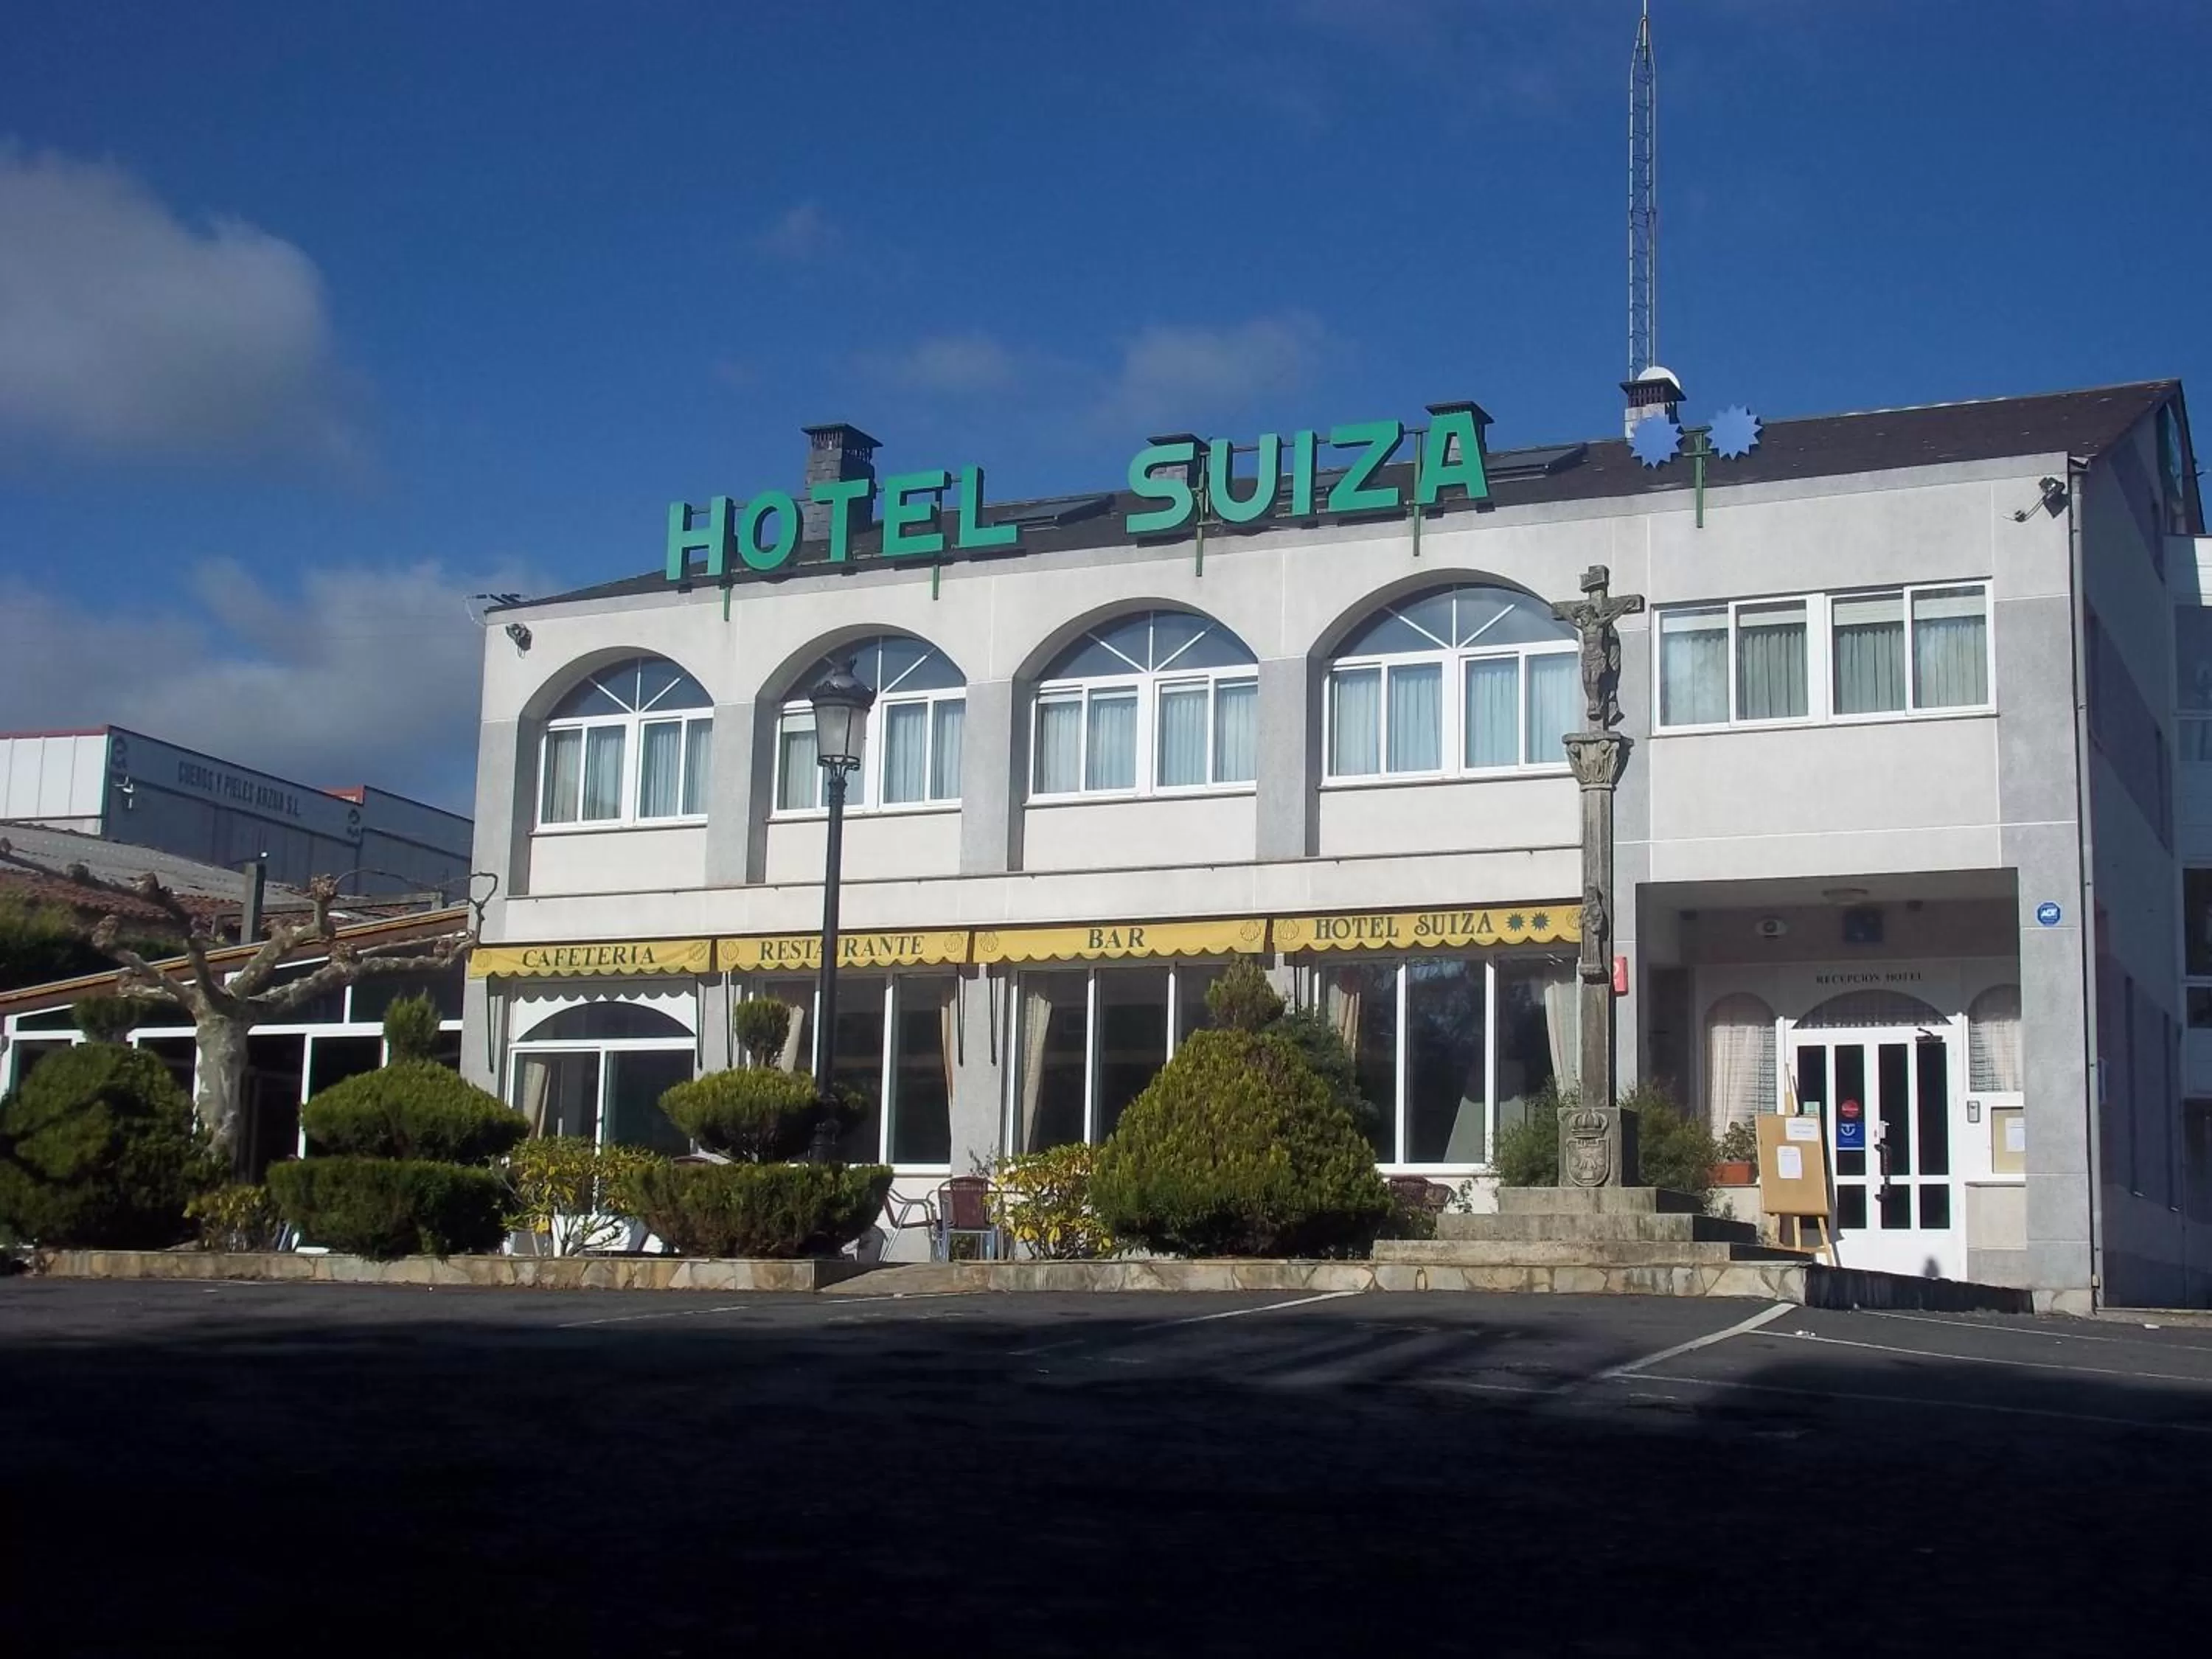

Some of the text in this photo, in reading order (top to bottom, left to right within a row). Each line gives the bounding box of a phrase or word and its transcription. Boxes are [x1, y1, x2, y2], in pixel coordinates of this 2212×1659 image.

[665, 410, 1491, 580] HOTEL SUIZA
[223, 775, 254, 804] PIELES
[1089, 928, 1144, 949] BAR
[1315, 911, 1494, 940] HOTEL SUIZA
[522, 945, 655, 968] CAFETERIA
[760, 935, 925, 961] RESTARANTE
[1885, 971, 1923, 983] HOTEL
